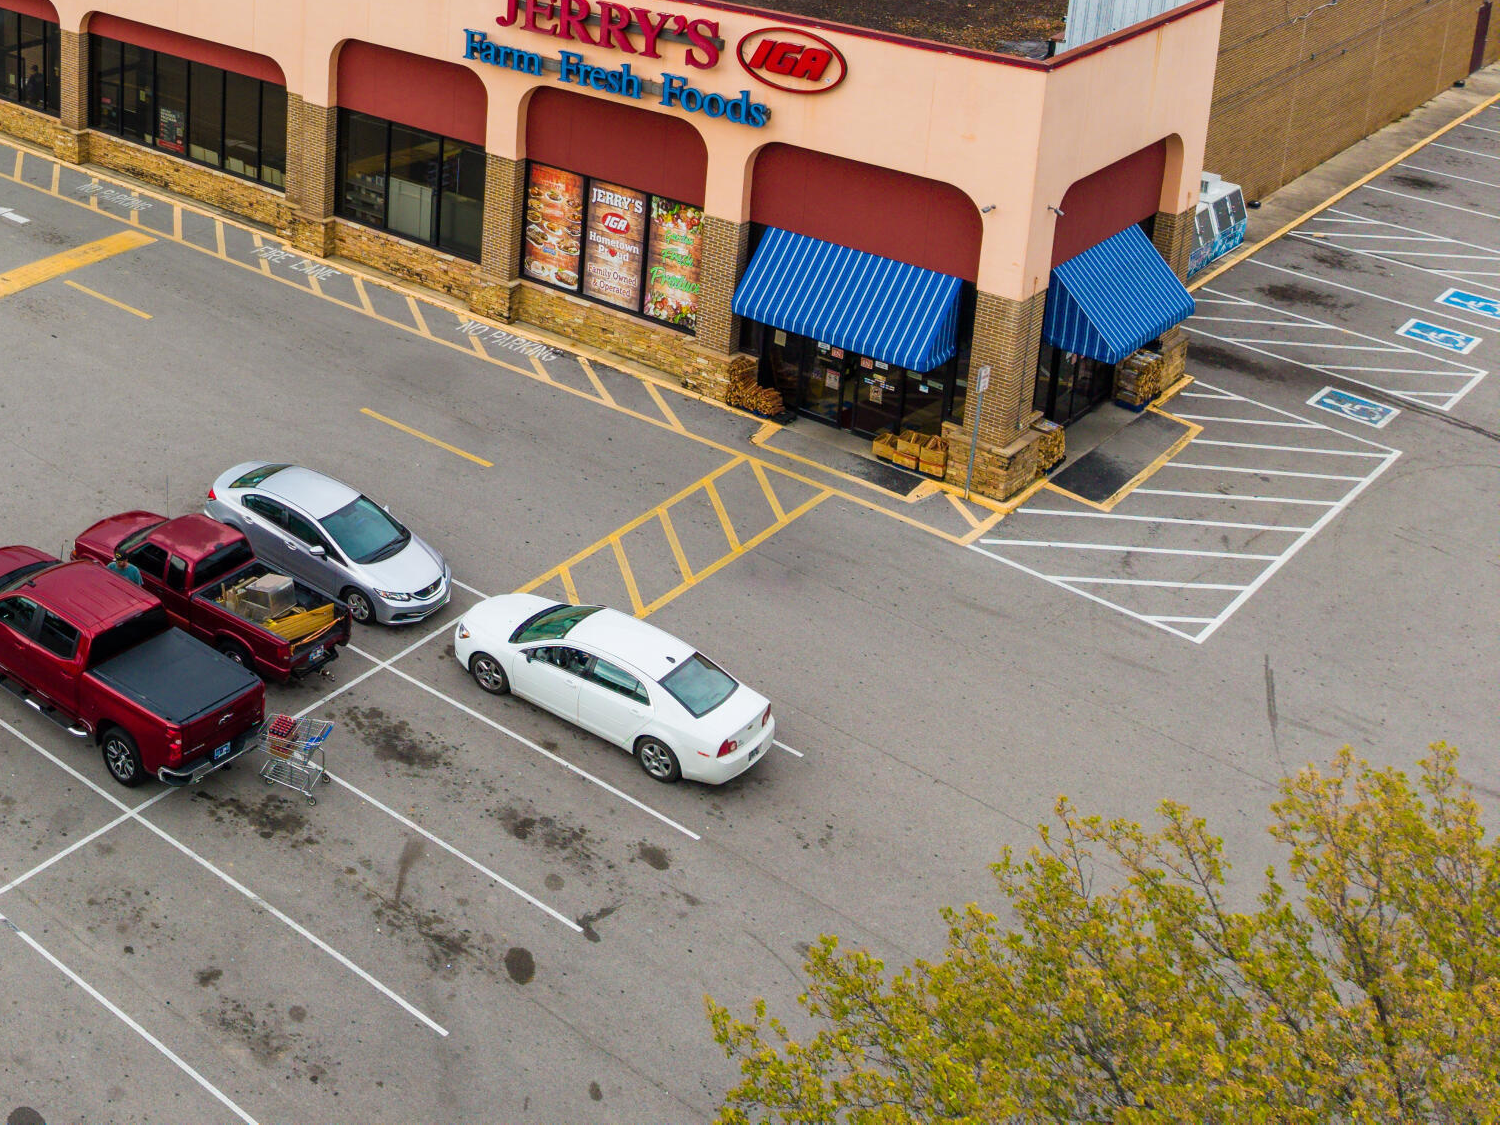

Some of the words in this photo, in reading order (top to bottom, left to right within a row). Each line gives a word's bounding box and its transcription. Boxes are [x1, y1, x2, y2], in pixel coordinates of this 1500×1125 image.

[750, 39, 833, 82] IGA
[463, 28, 543, 76] Farm
[558, 50, 643, 99] Fresh
[660, 72, 768, 128] Foods
[592, 187, 643, 214] JERRY'S
[604, 215, 628, 231] IGA
[589, 231, 639, 255] Hometown
[598, 244, 629, 262] Prud
[250, 246, 295, 263] FIRE
[289, 259, 342, 281] LANE
[588, 263, 611, 280] Family
[612, 271, 637, 287] Owned
[599, 280, 631, 297] Operated
[490, 330, 557, 362] PARKING
